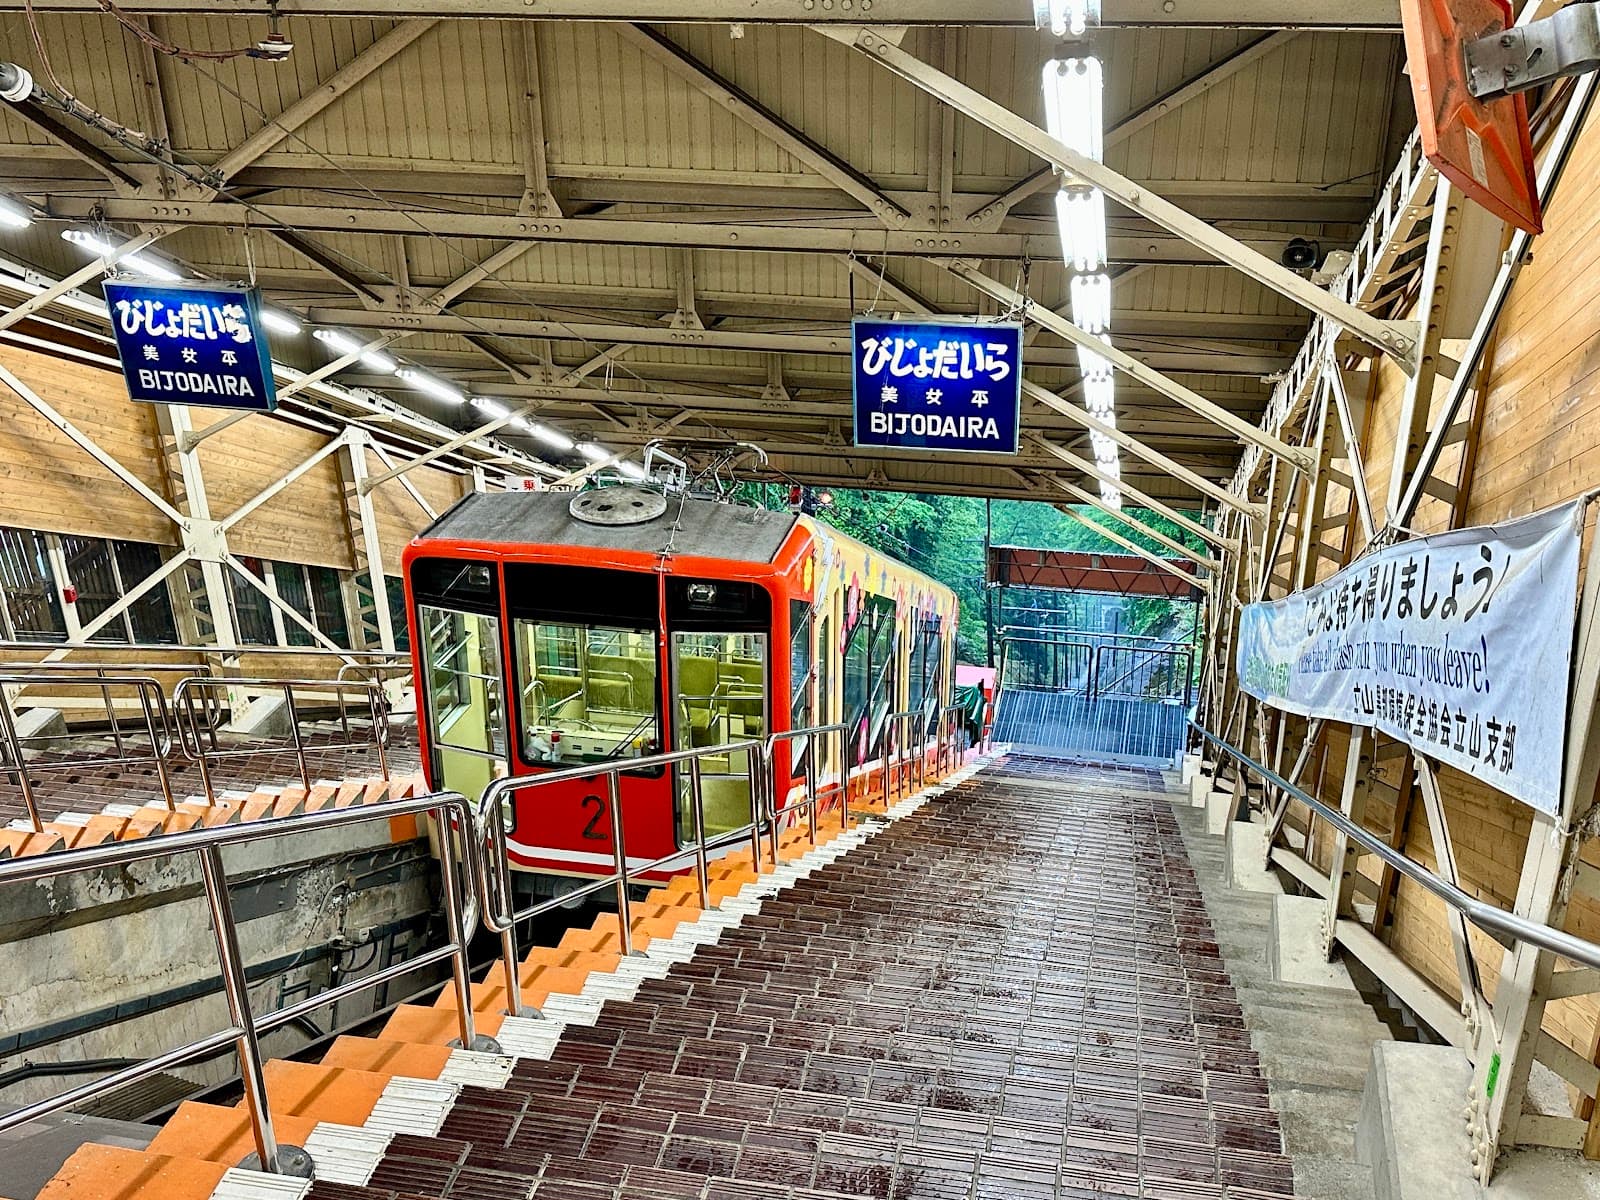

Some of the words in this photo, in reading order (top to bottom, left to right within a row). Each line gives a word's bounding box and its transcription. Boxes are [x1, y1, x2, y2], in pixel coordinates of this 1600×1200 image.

[861, 336, 1011, 382] びじょだいら
[138, 369, 255, 397] BIJODAIRA
[870, 411, 1000, 440] BIJODAIRA
[1373, 641, 1388, 676] you
[1391, 629, 1418, 678] when
[1420, 645, 1442, 687] you
[1443, 632, 1490, 694] leave!
[582, 795, 608, 839] 2
